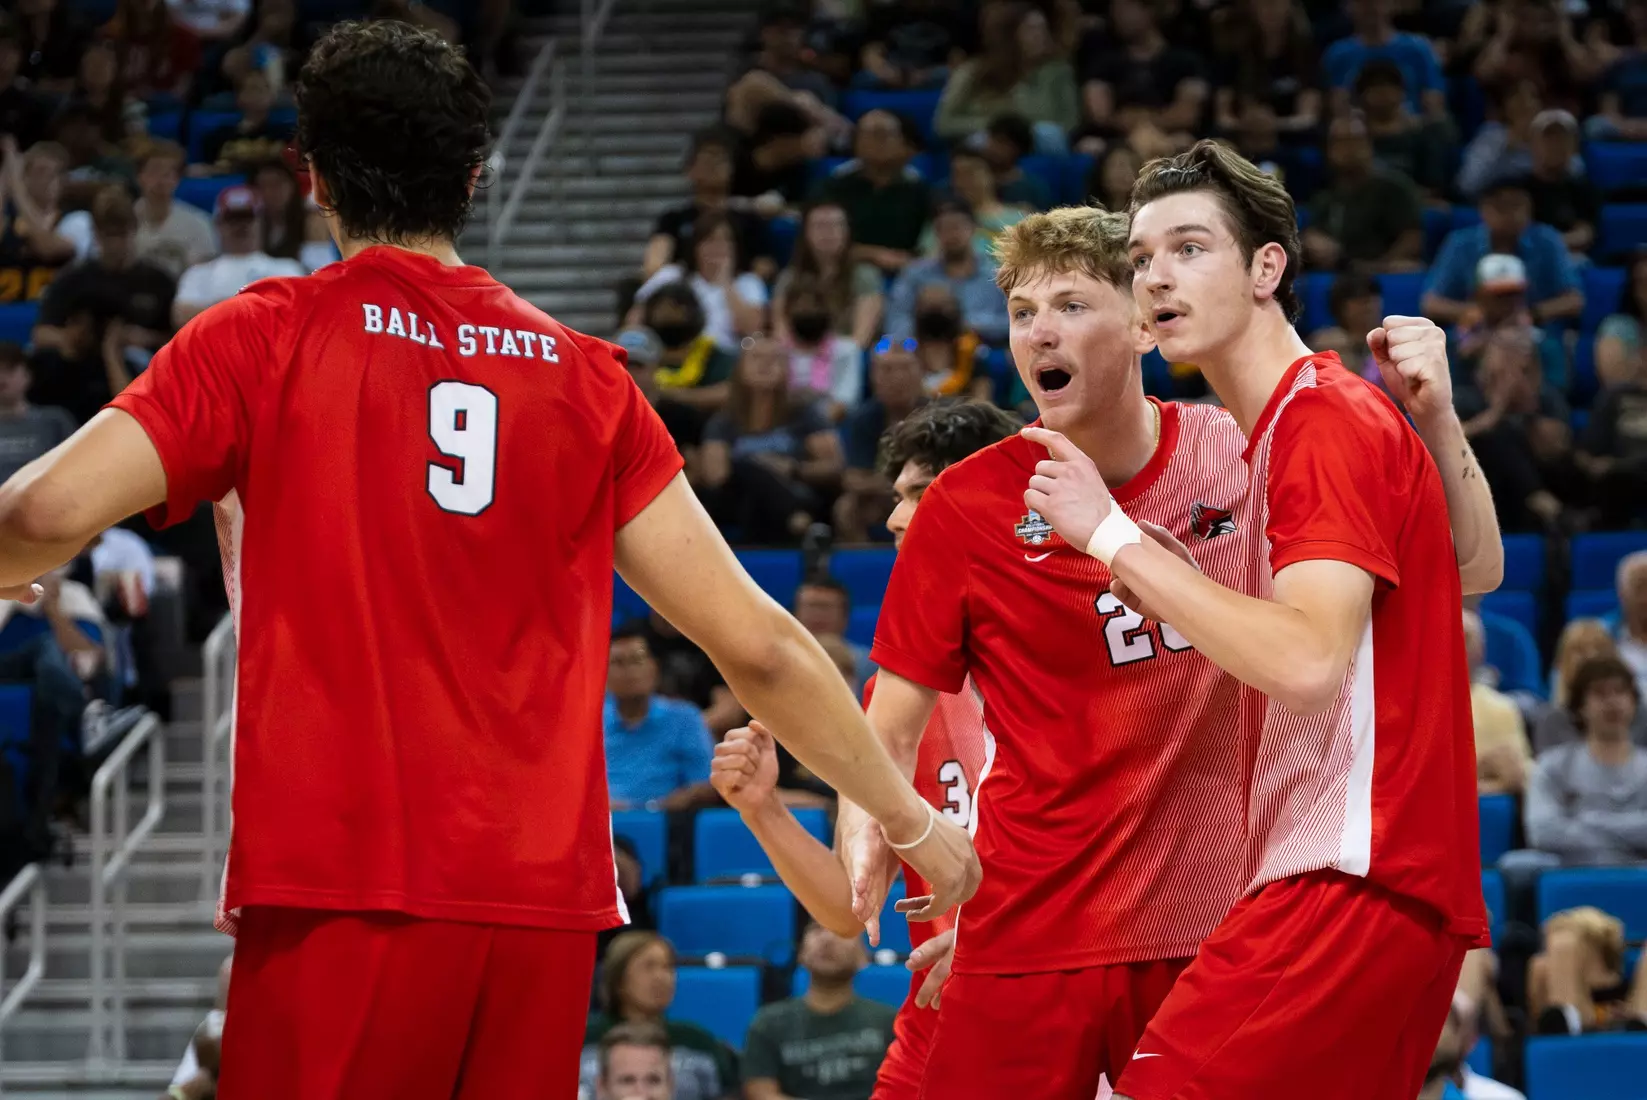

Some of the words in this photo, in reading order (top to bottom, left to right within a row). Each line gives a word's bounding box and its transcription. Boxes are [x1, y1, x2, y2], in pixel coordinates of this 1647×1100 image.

[457, 324, 560, 364] STATE
[426, 379, 498, 517] 9
[938, 759, 972, 830] 3
